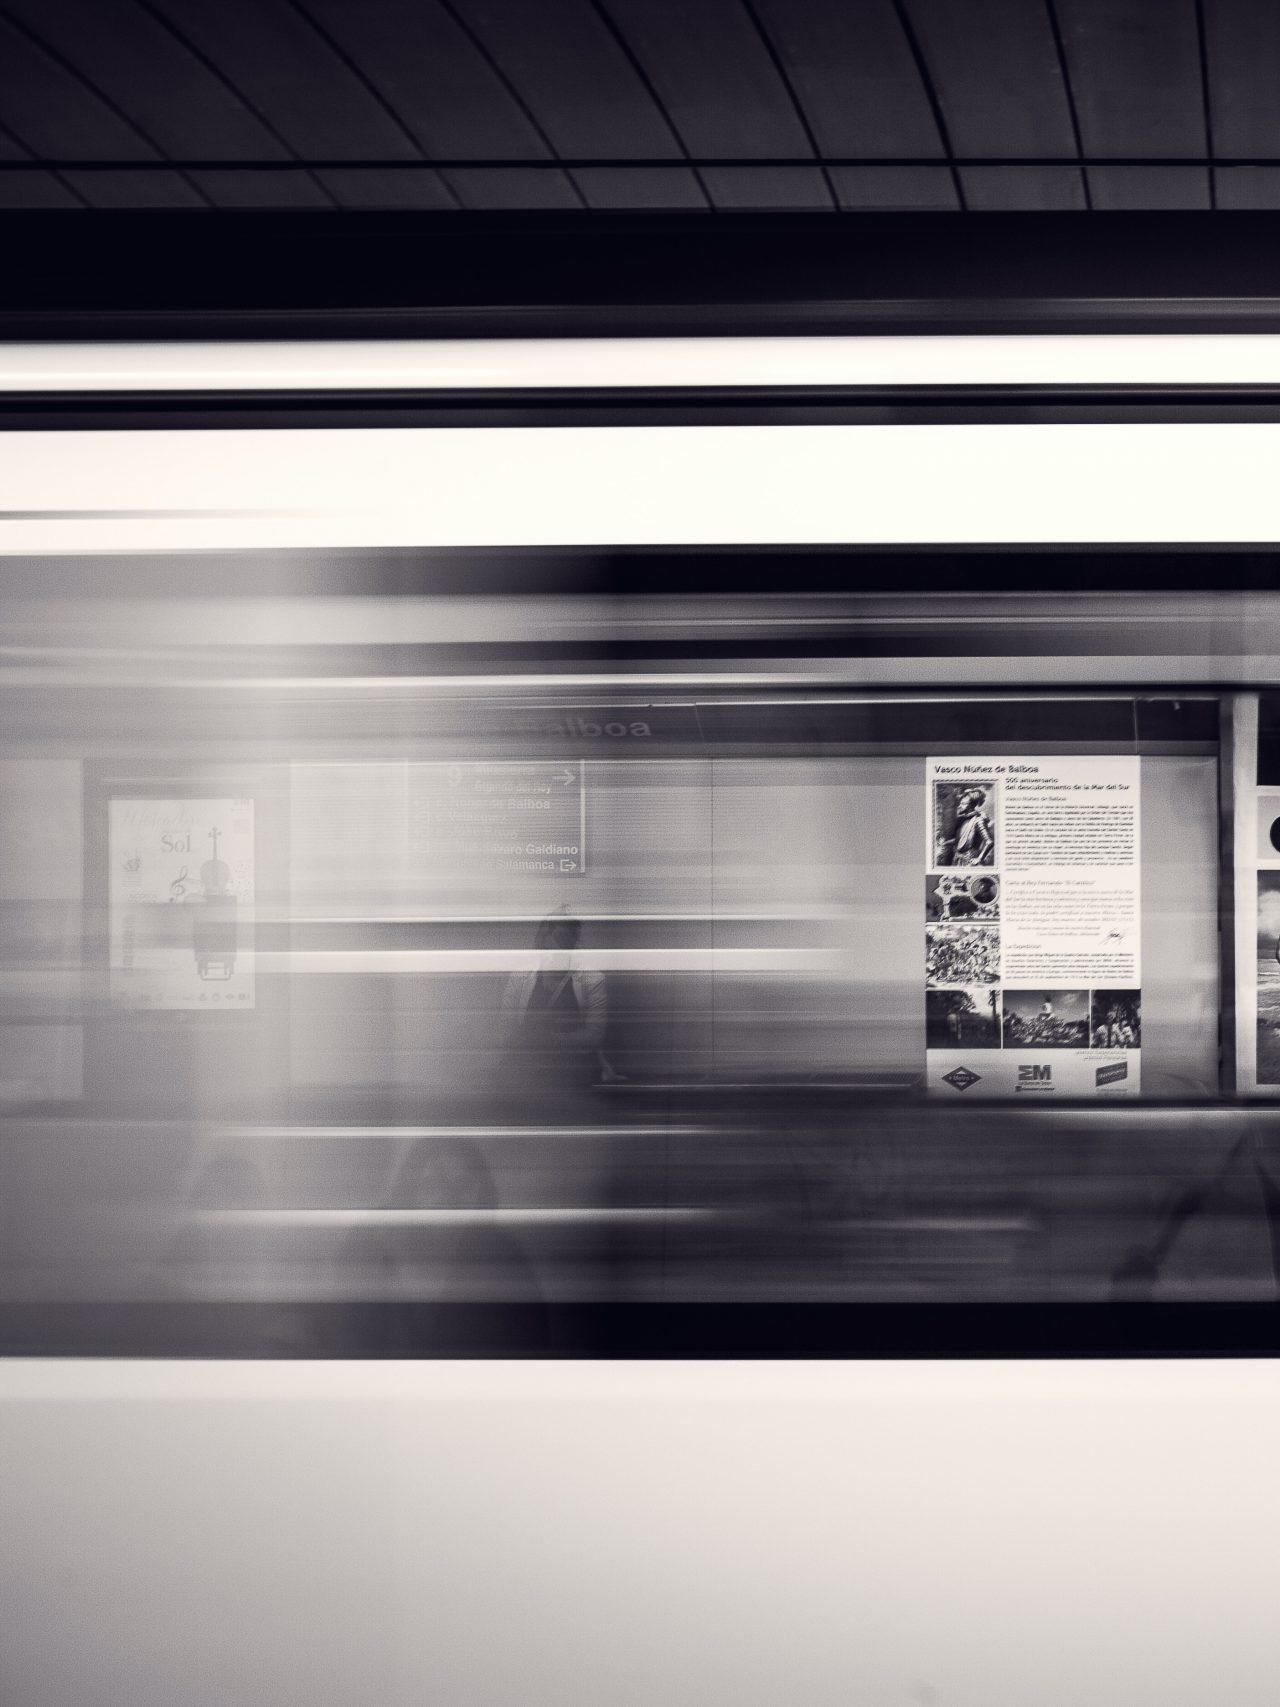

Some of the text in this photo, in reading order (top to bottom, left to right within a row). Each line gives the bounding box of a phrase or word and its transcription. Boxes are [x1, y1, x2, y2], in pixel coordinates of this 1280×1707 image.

[543, 717, 652, 737] alboa
[934, 765, 961, 774] Vasco
[994, 765, 1006, 774] de
[1008, 765, 1039, 774] Balboa
[160, 833, 192, 854] Sol
[525, 843, 579, 855] Galdiano
